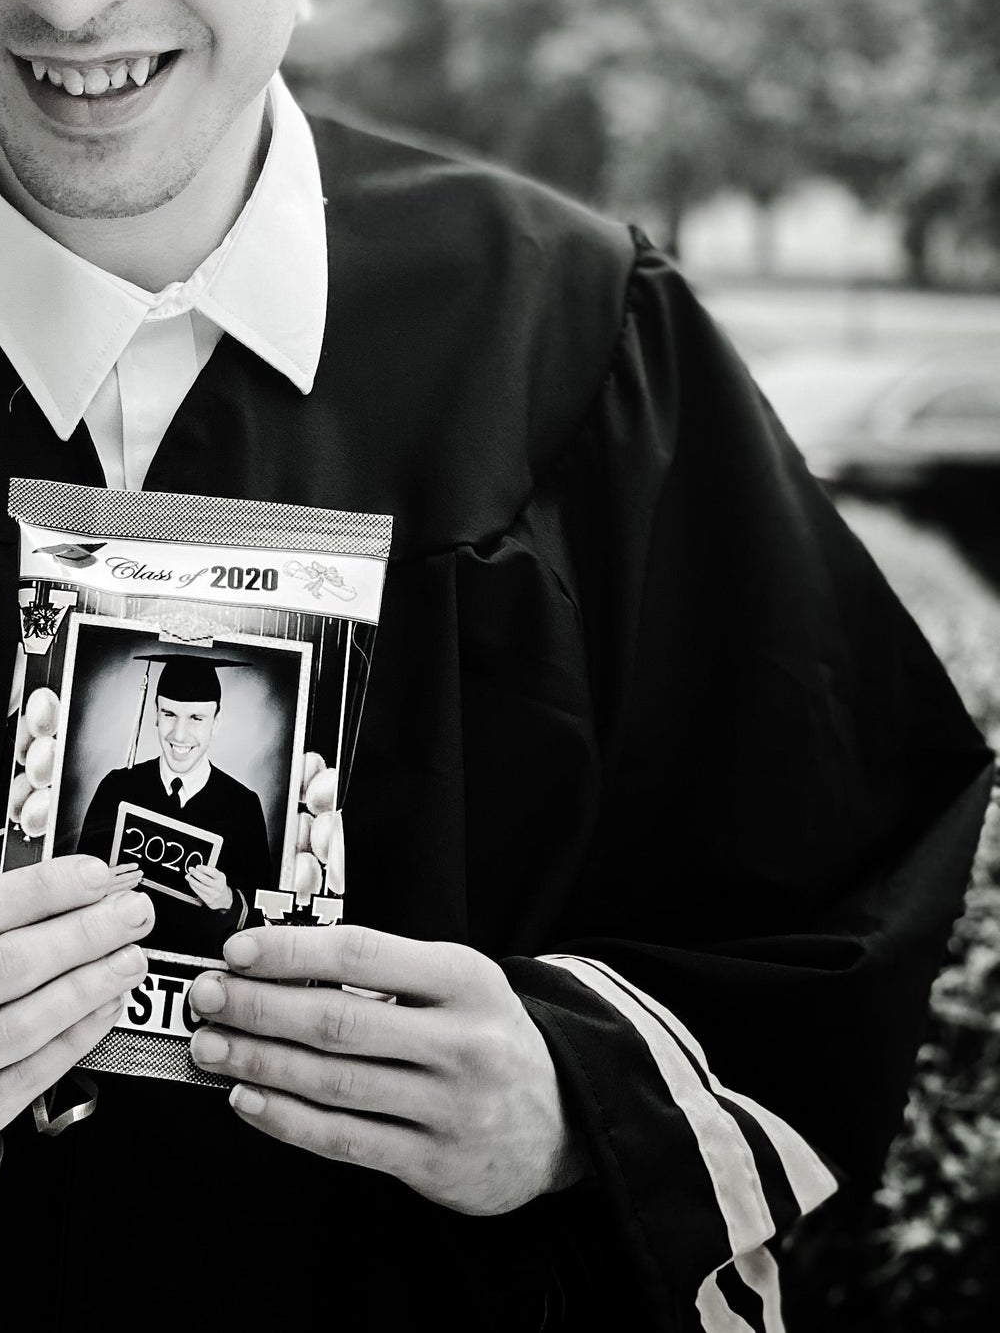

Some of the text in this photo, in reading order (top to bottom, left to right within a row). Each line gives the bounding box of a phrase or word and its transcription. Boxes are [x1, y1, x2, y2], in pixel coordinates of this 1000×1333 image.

[105, 556, 279, 592] Class of 2020
[122, 827, 204, 874] 2020
